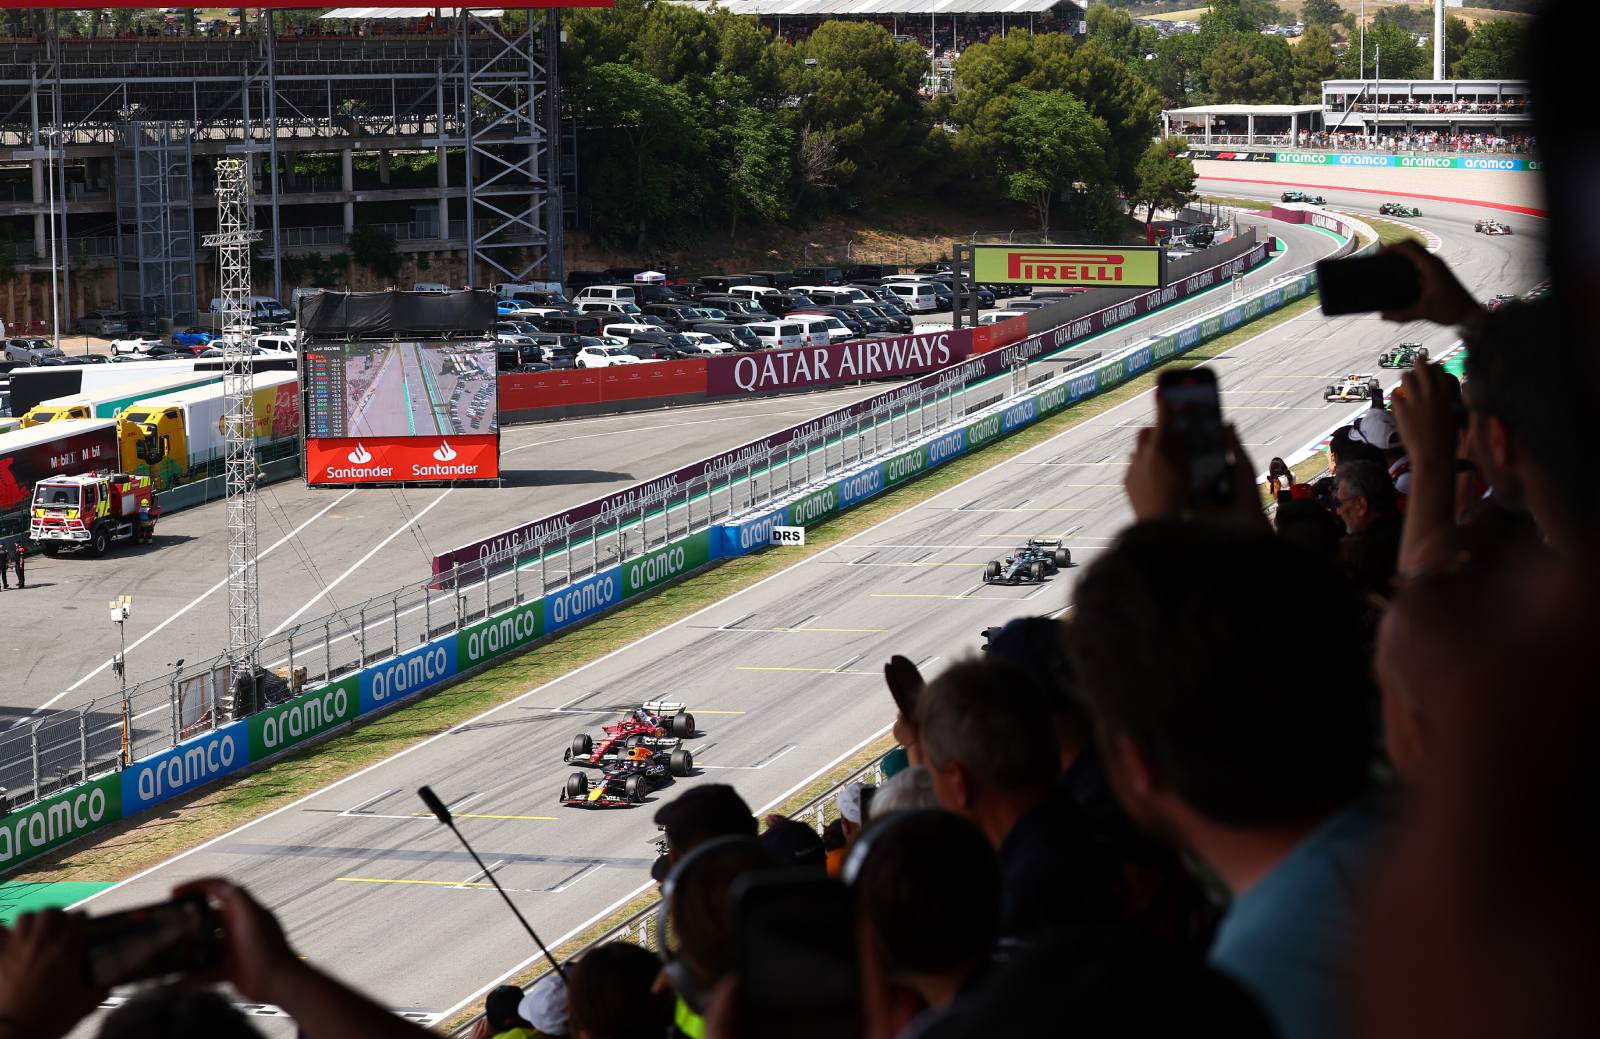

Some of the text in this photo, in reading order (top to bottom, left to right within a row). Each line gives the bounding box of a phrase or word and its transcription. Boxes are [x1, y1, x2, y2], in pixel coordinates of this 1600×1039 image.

[1279, 153, 1326, 164] aramco
[1339, 155, 1388, 166] aramco
[1402, 156, 1450, 167] aramco
[1464, 158, 1514, 170] aramco
[1008, 253, 1124, 281] PIRELLI
[1102, 301, 1137, 328] QATAR AIRWAYS
[1055, 318, 1092, 347] QATAR AIRWAYS
[1000, 337, 1042, 368] QATAR AIRWAYS
[1129, 350, 1149, 372] aramco
[1155, 338, 1174, 359] aramco
[734, 348, 831, 392] QATAR
[838, 334, 951, 377] AIRWAYS
[940, 358, 986, 392] QATAR AIRWAYS
[1102, 363, 1123, 385] aramco
[1040, 387, 1065, 411] aramco
[1071, 374, 1096, 397] aramco
[1005, 402, 1033, 428] aramco
[970, 416, 998, 443] aramco
[930, 433, 962, 461] aramco
[327, 465, 394, 478] Santander
[412, 463, 478, 476] Santander
[889, 450, 922, 480] aramco
[844, 469, 880, 500] aramco
[601, 475, 679, 524] QATAR AIRWAYS
[795, 491, 833, 524] aramco
[480, 514, 571, 568] QATAR AIRWAYS
[773, 531, 801, 541] DRS
[630, 545, 684, 590] aramco
[553, 576, 613, 623] aramco
[468, 610, 534, 660] aramco
[373, 646, 447, 700] aramco
[263, 687, 347, 748] aramco
[139, 735, 235, 800] aramco
